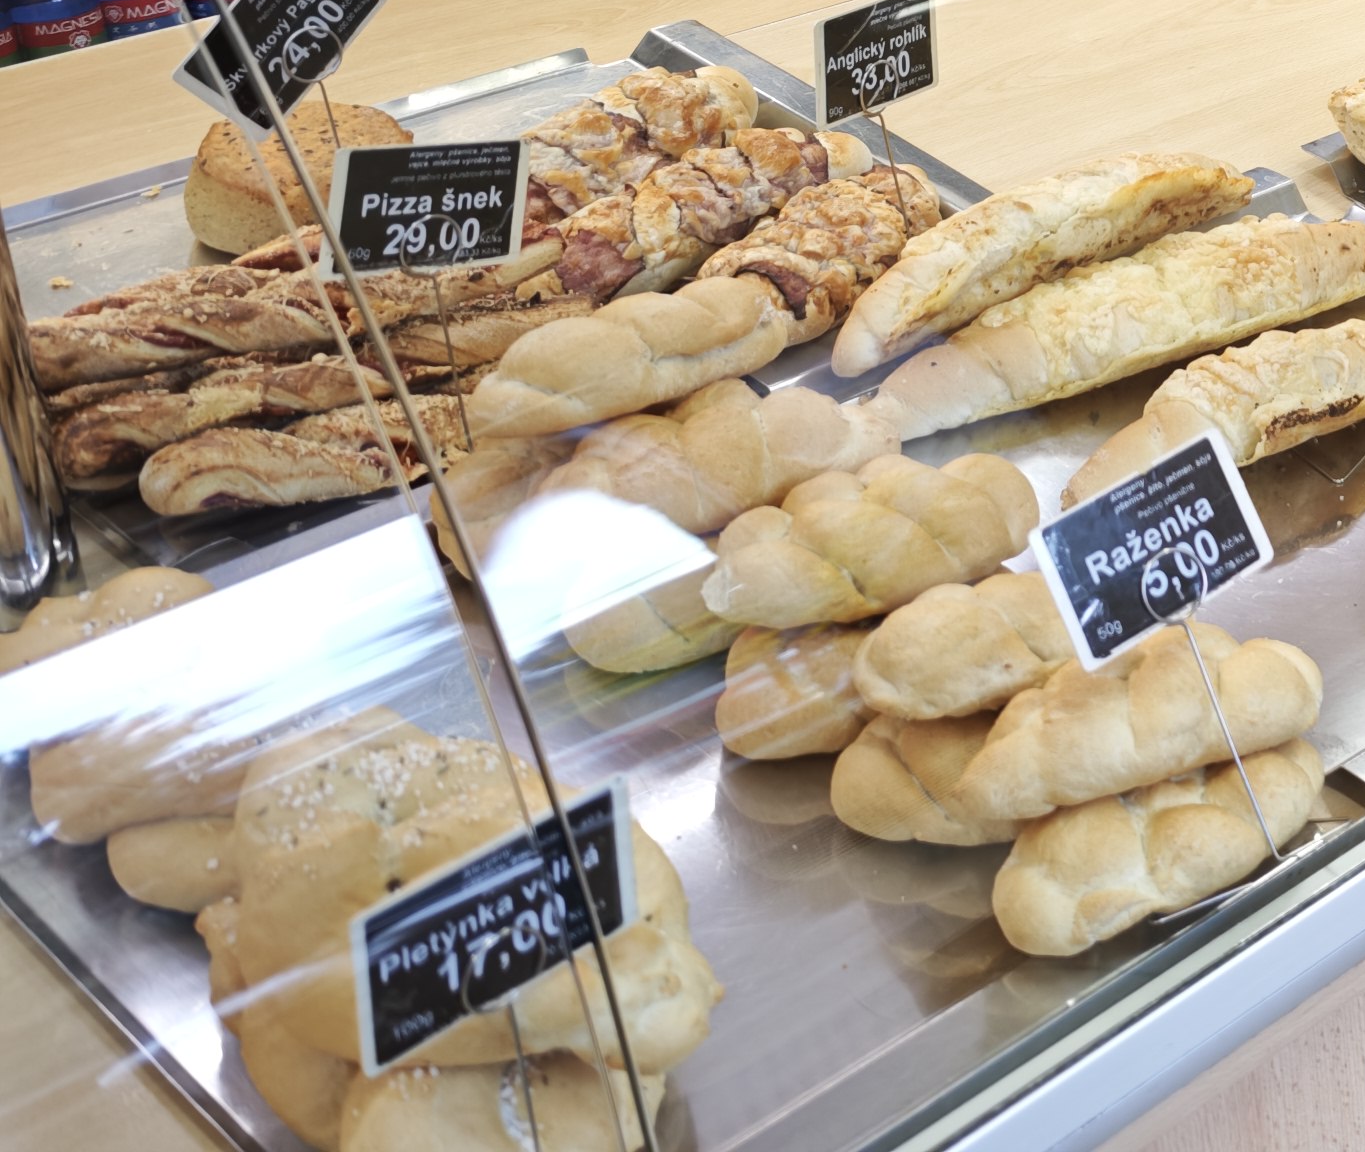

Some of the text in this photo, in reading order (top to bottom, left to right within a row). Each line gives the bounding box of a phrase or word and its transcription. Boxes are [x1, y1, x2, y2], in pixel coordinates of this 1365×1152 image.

[268, 0, 344, 84] 24,00
[826, 23, 927, 75] Anglický rohlík
[829, 106, 844, 118] 90g
[361, 185, 504, 218] Pizza šnek
[383, 217, 481, 257] 29,00
[1085, 497, 1216, 585] Raženka
[1097, 619, 1124, 640] 50g
[378, 894, 514, 984] Pletýnka
[436, 892, 568, 992] 17,00
